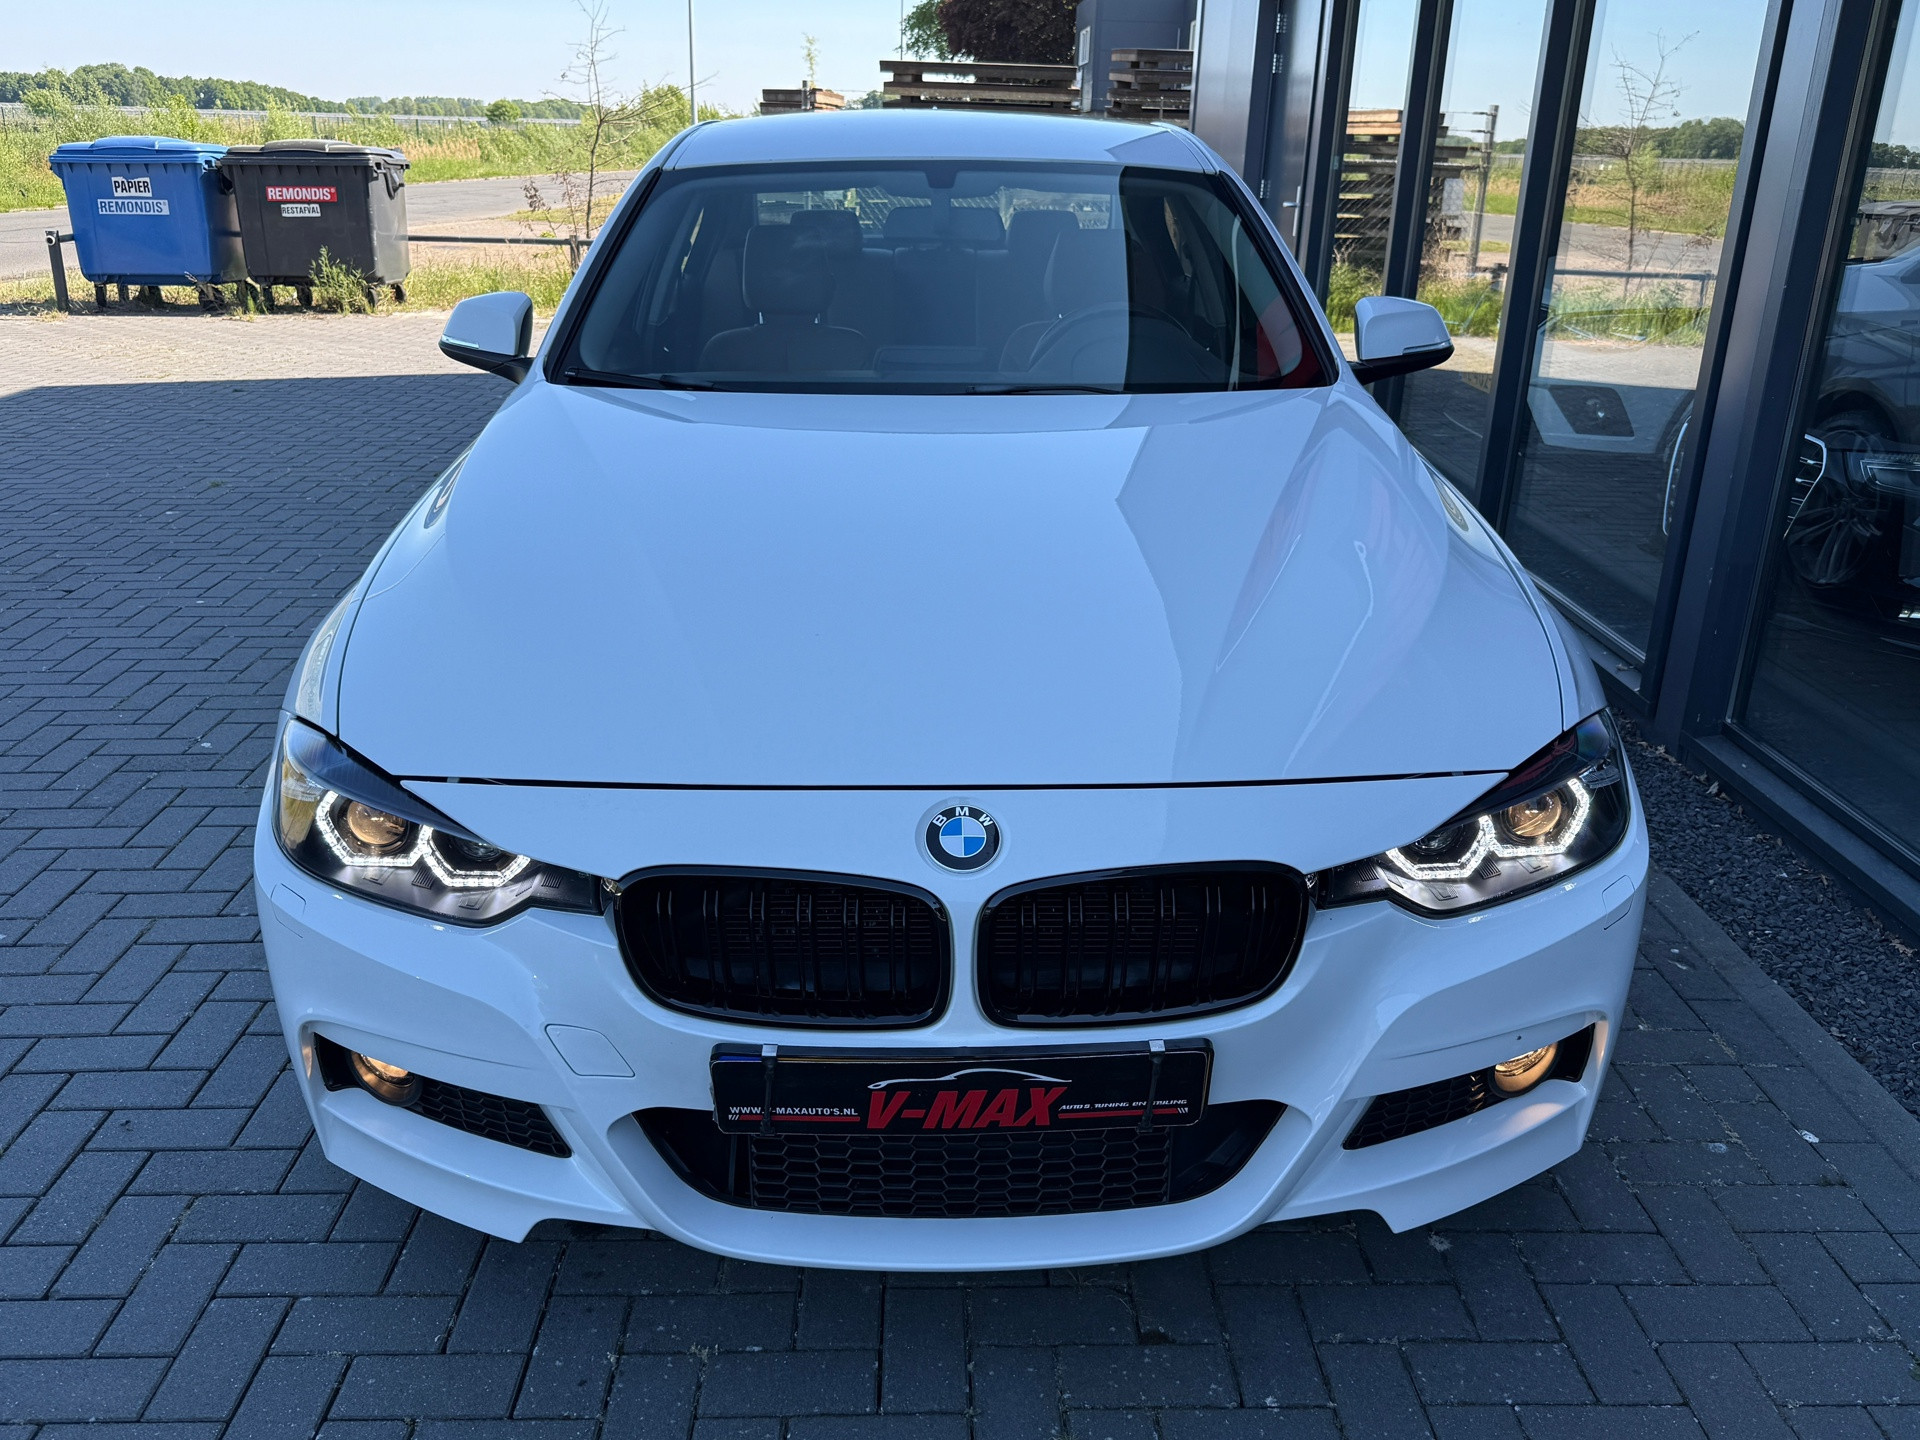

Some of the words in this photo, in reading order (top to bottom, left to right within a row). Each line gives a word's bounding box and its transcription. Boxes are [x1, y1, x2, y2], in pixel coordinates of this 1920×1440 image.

[113, 180, 151, 193] PAPIER
[282, 206, 320, 215] RESTAFVAL
[932, 806, 993, 827] BMW
[729, 1106, 858, 1116] WWW.-MAXAUTO'S.NL
[867, 1087, 1067, 1129] V-MAX
